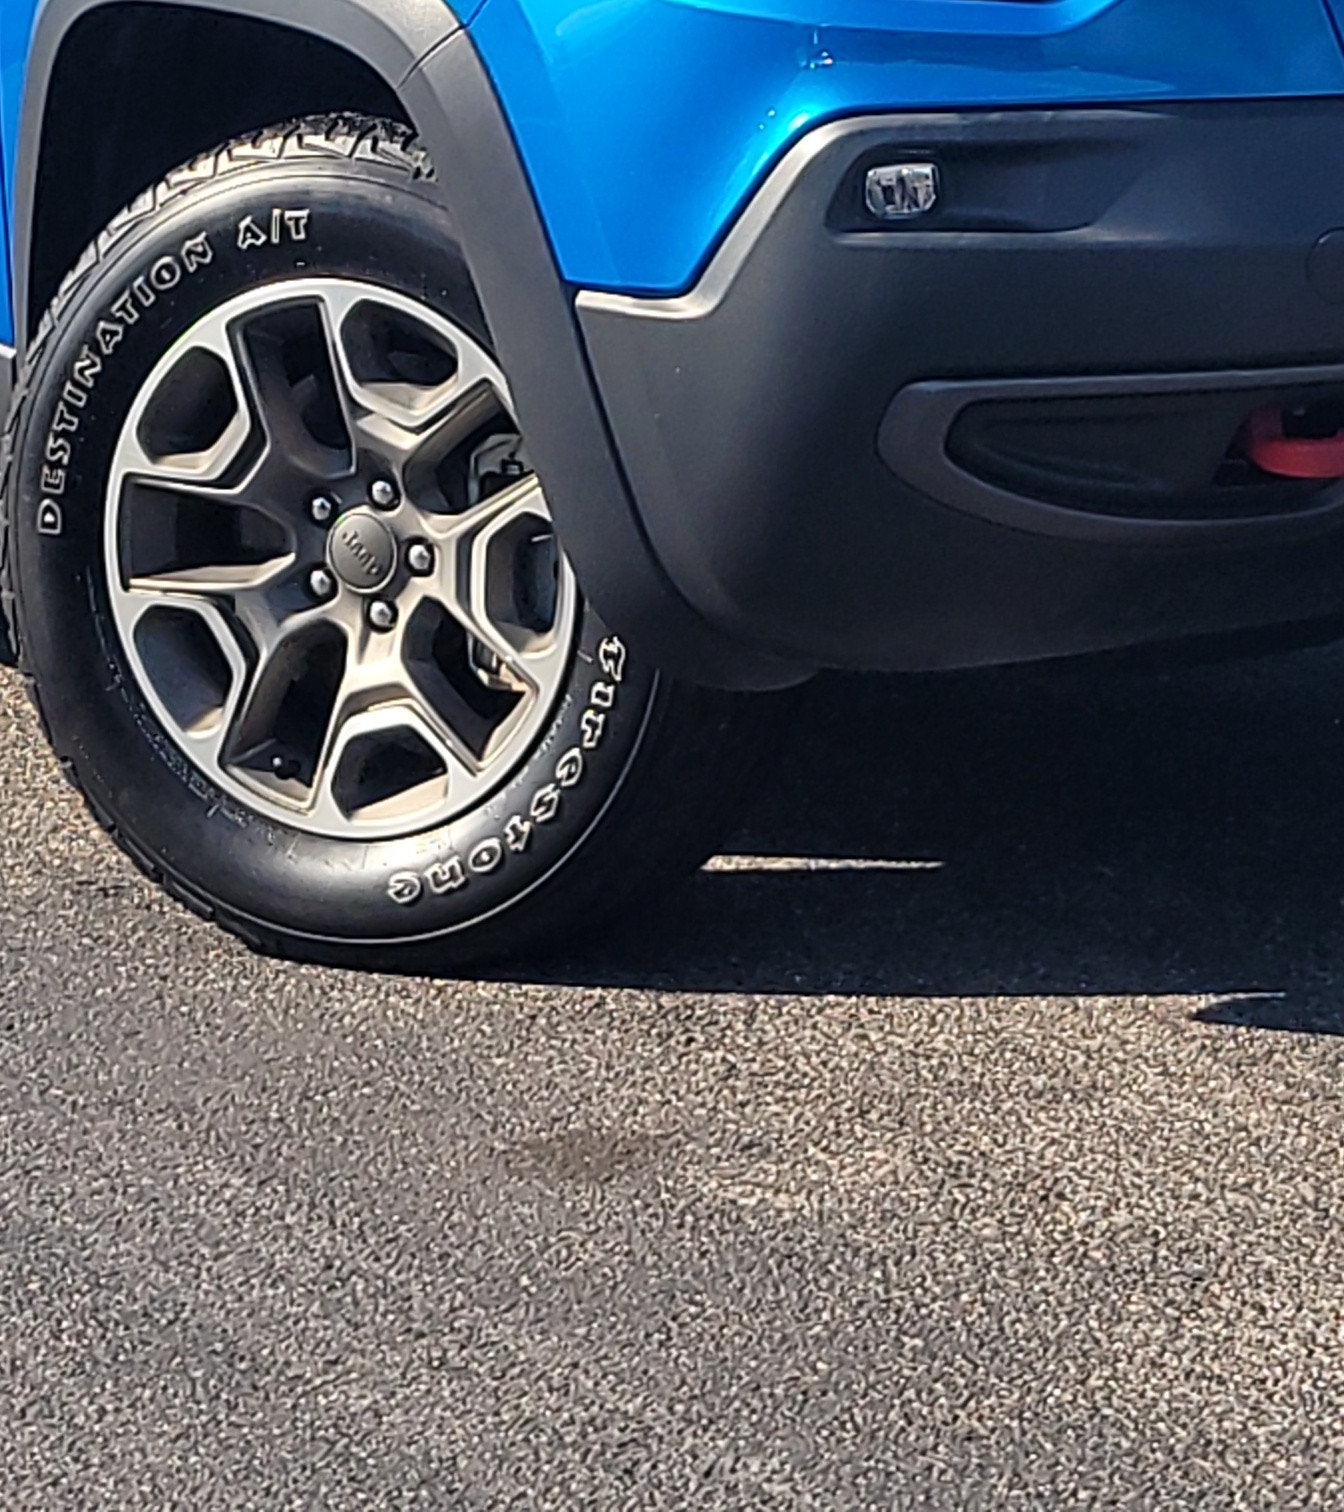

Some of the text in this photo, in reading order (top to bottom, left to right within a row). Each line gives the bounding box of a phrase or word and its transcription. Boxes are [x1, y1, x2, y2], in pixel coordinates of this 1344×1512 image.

[37, 229, 216, 536] DESTINATION
[236, 207, 311, 252] A/T
[386, 635, 627, 905] Firestone
